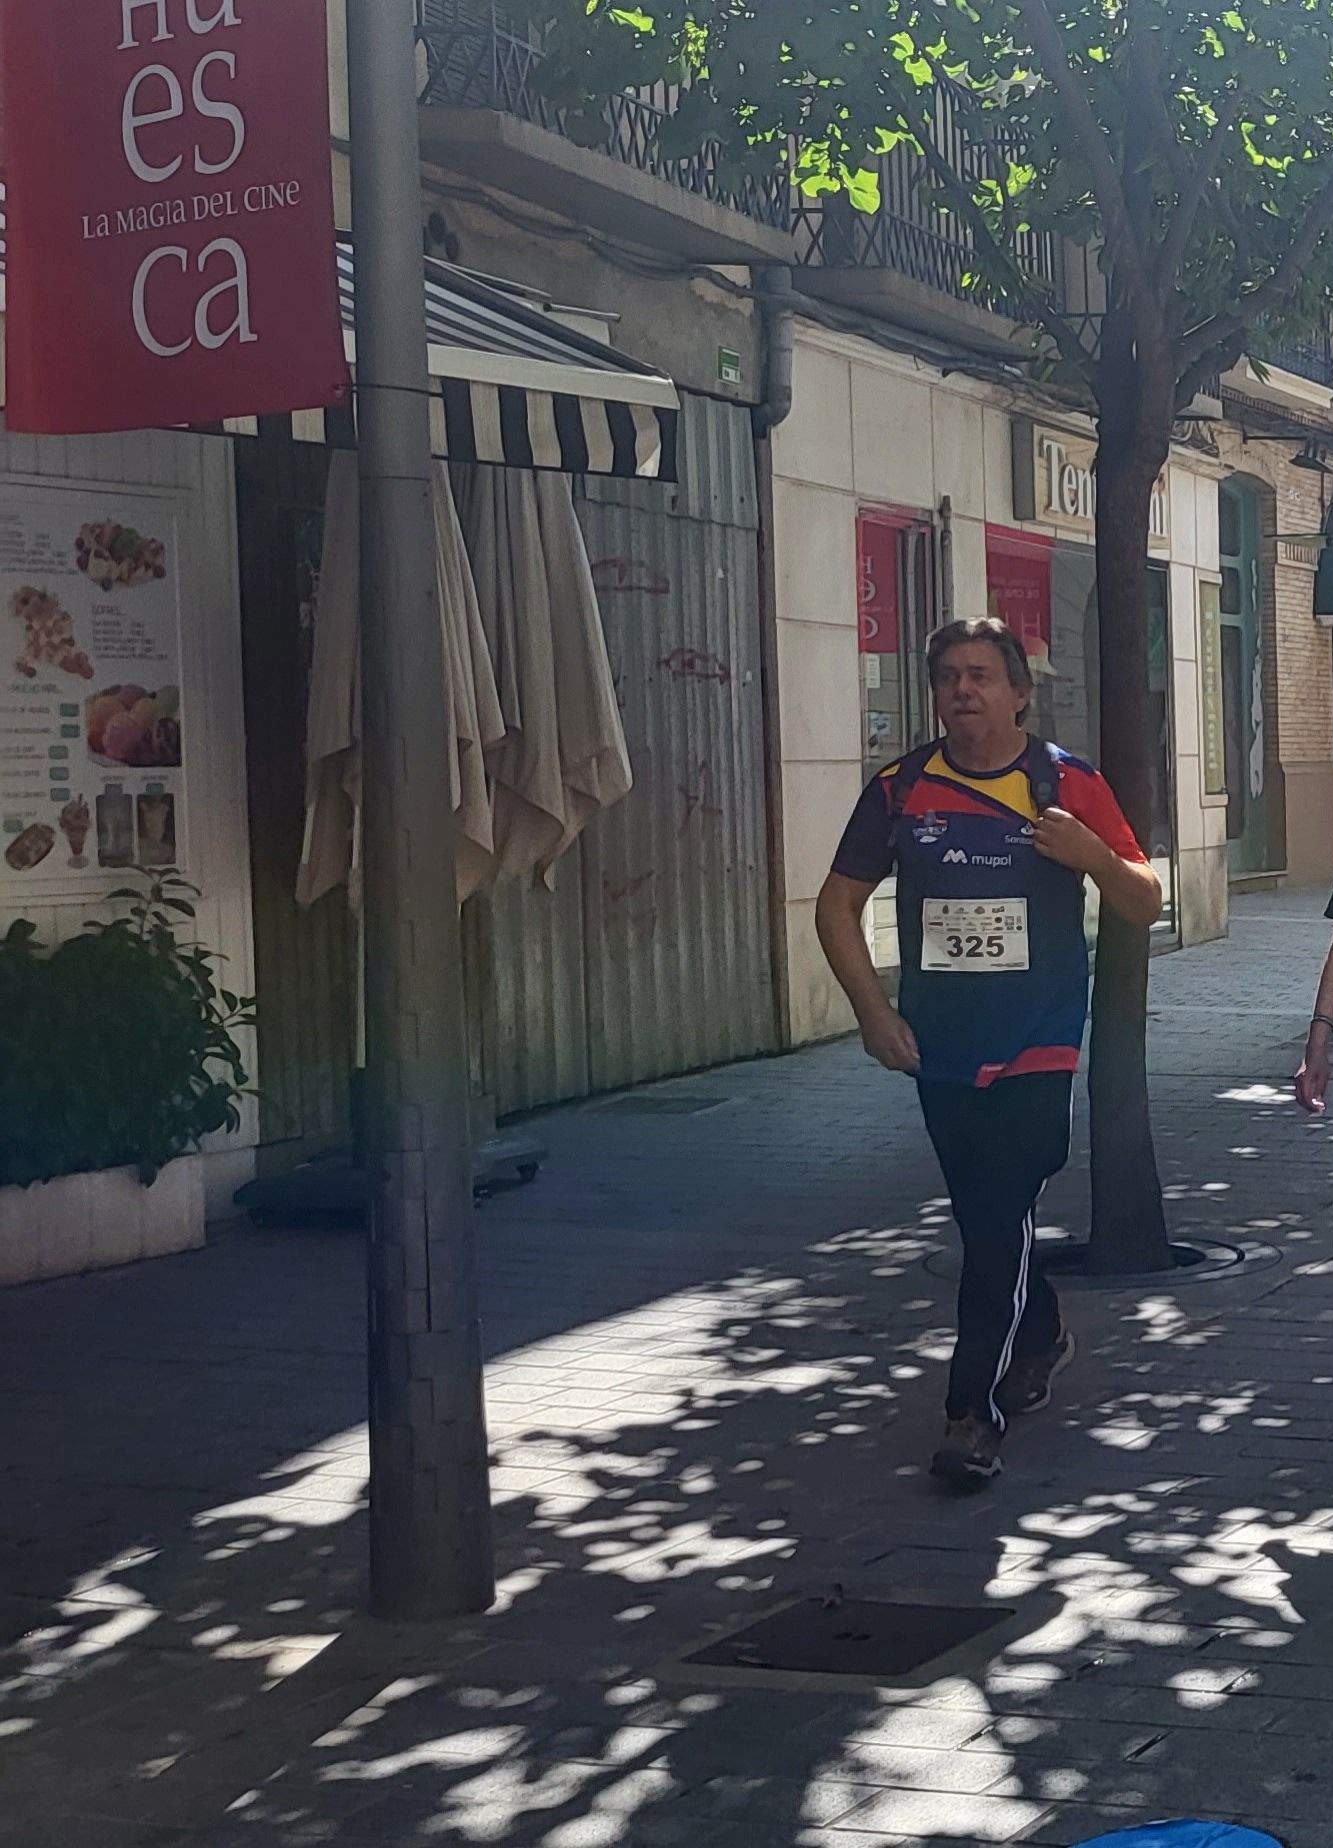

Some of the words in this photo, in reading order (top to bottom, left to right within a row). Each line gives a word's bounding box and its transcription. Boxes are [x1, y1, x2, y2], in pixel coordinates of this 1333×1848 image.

[121, 50, 246, 183] es
[131, 236, 259, 357] ca
[971, 854, 1012, 867] mupol
[946, 935, 1005, 958] 325
